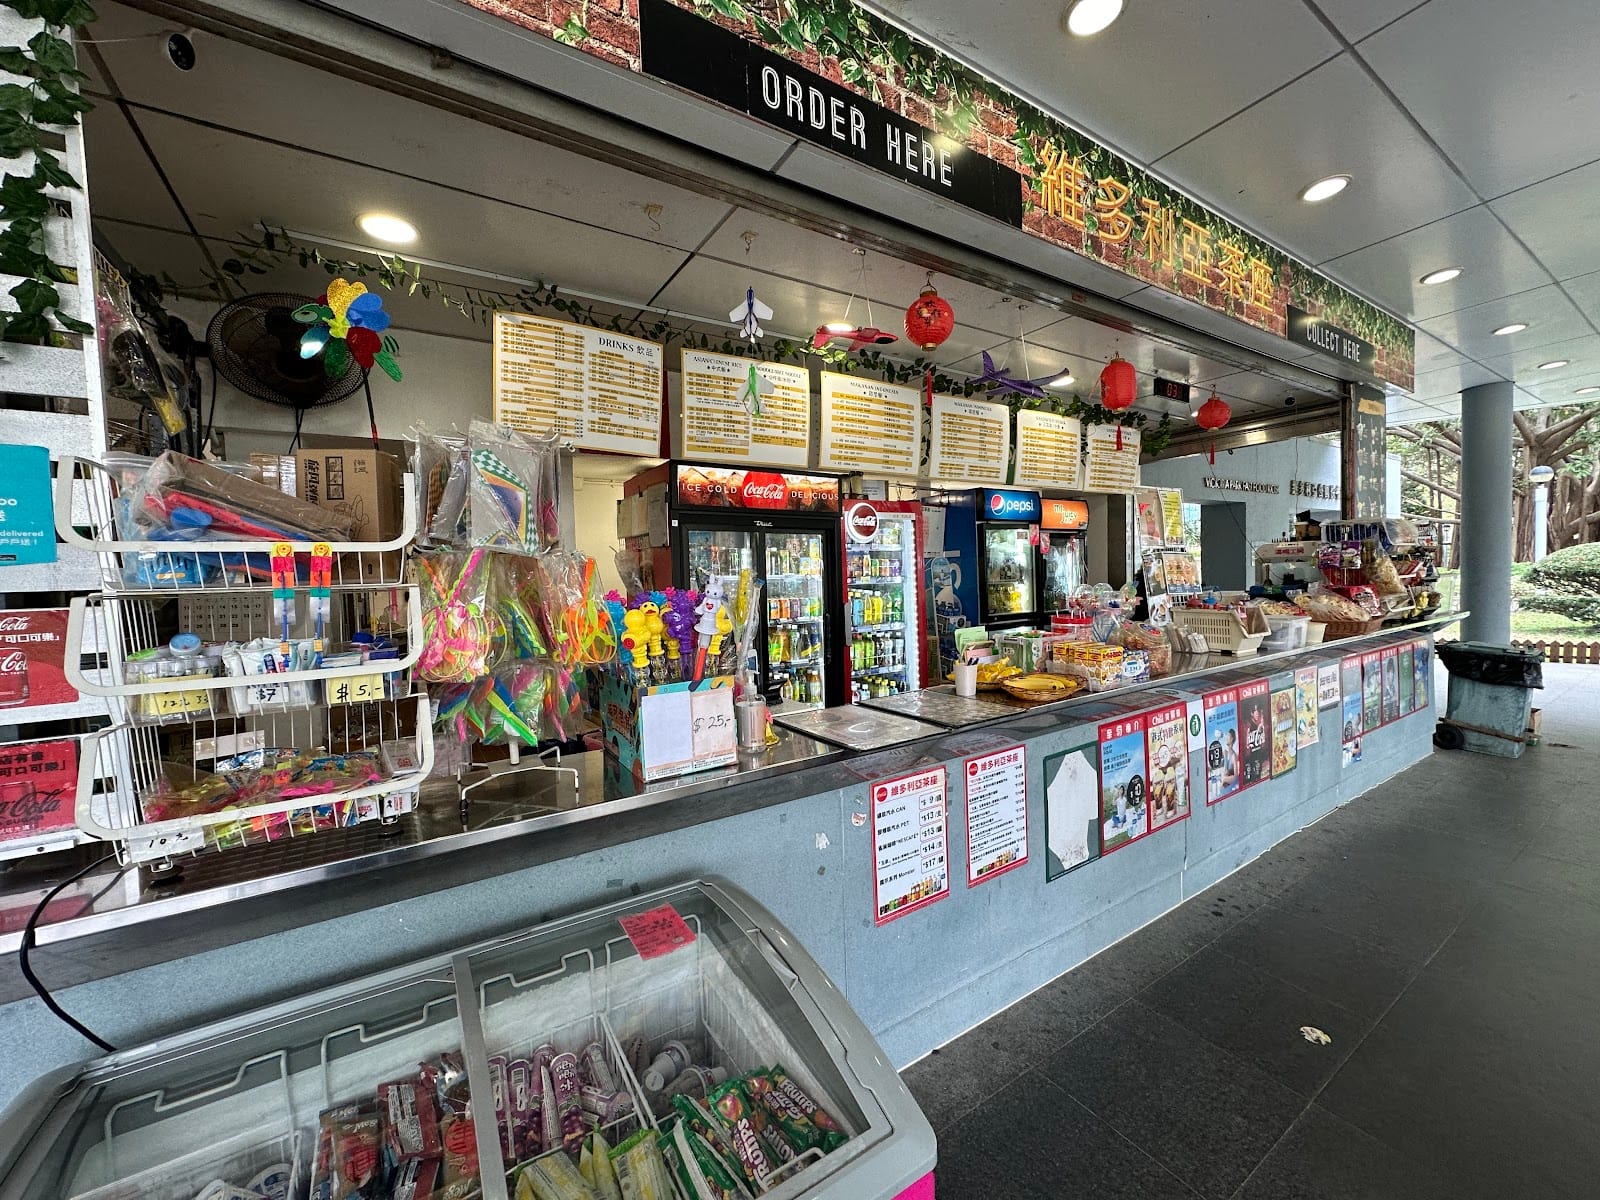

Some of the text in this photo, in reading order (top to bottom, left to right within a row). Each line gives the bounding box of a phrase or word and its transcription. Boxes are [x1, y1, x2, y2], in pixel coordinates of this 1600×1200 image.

[761, 66, 953, 187] ORDER HERE
[1041, 141, 1274, 313] 維多利亞茶座
[598, 336, 634, 353] DRINKS
[1306, 323, 1361, 364] COLLECT HERE
[681, 483, 738, 495] ICE COLD
[743, 481, 786, 501] Coca-Cola
[790, 489, 839, 501] DELICIOUS
[1006, 498, 1034, 514] pepsi
[852, 514, 877, 528] Coca-Cola
[980, 752, 1019, 772] 維多利亞茶座
[890, 774, 938, 797] 維多利亞茶座
[896, 805, 906, 815] CAN
